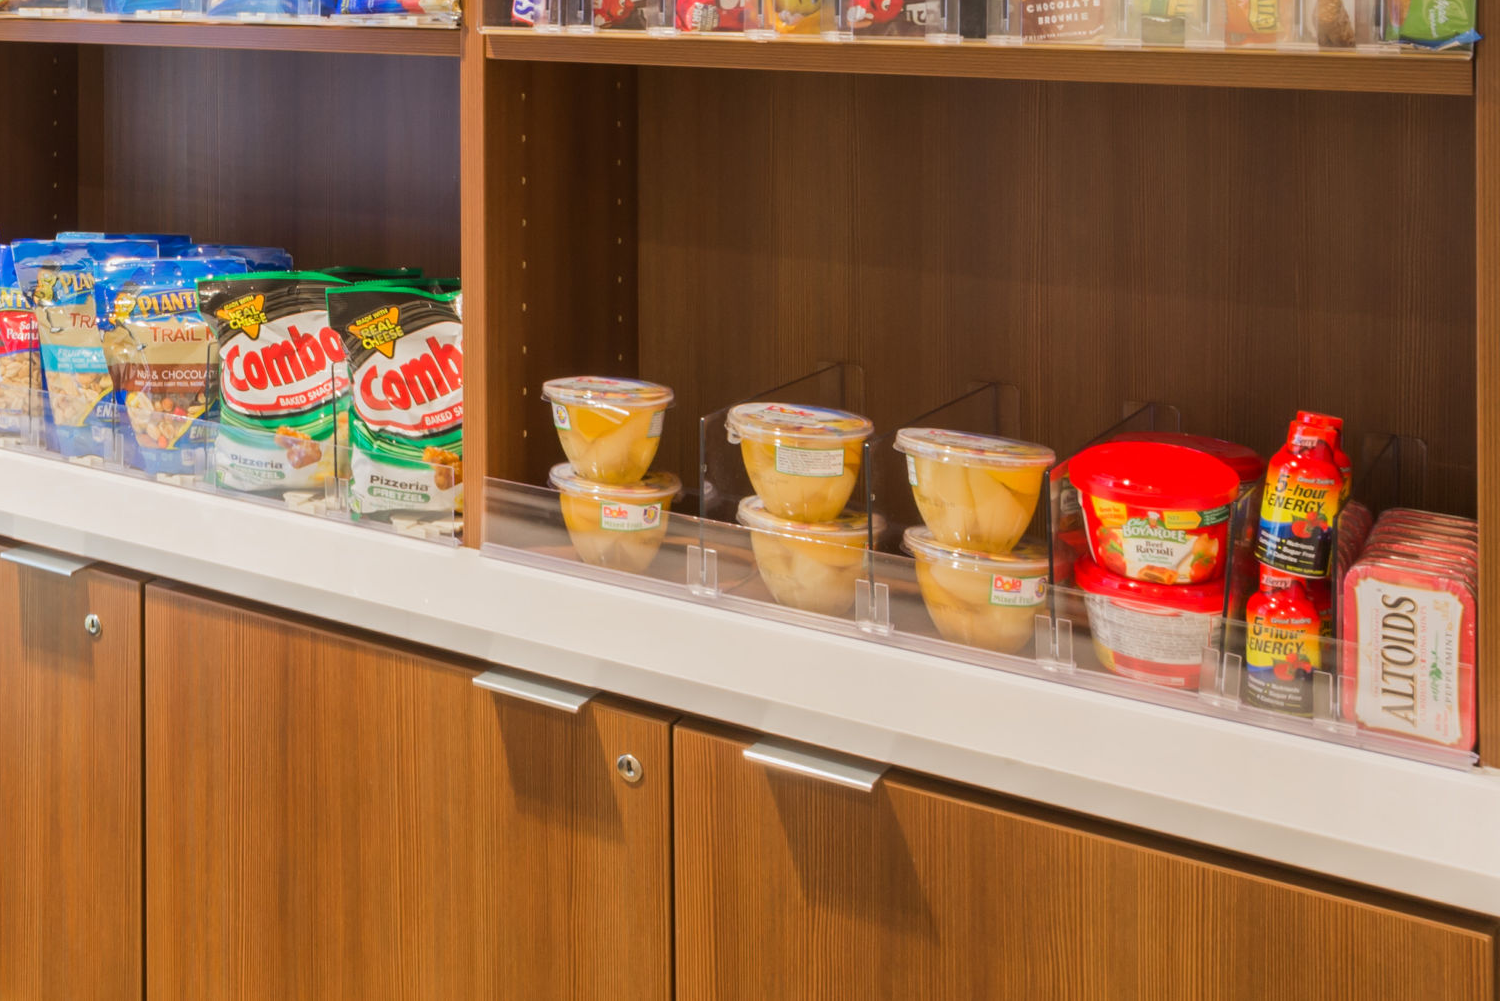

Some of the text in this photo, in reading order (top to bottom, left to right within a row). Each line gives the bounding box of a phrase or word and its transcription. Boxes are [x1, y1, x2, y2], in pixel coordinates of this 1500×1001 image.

[1038, 12, 1088, 25] BROWNIE
[228, 305, 260, 321] REAL
[229, 312, 268, 330] CHEESE
[373, 307, 389, 320] WITH
[150, 327, 201, 343] TRAIL
[360, 319, 396, 337] REAL
[362, 326, 405, 351] CHEESE
[226, 325, 347, 391] Combo
[279, 378, 343, 408] BAKED SNACKS
[425, 411, 453, 426] BAKED
[231, 451, 283, 470] Pizzeria
[369, 475, 430, 493] Pizzeria
[1275, 473, 1328, 500] 5-hour
[372, 486, 426, 503] PRETZEL
[603, 506, 628, 519] Dole
[1267, 494, 1325, 514] ENERGY
[1123, 524, 1187, 543] BOYARDEE
[1135, 545, 1174, 558] Ravioli
[1145, 540, 1164, 549] Beef
[994, 576, 1022, 592] Dole
[1264, 577, 1289, 588] Berry
[1253, 616, 1306, 640] 5-hour
[1249, 638, 1305, 656] ENERGY
[1381, 593, 1418, 728] ALTOIDS
